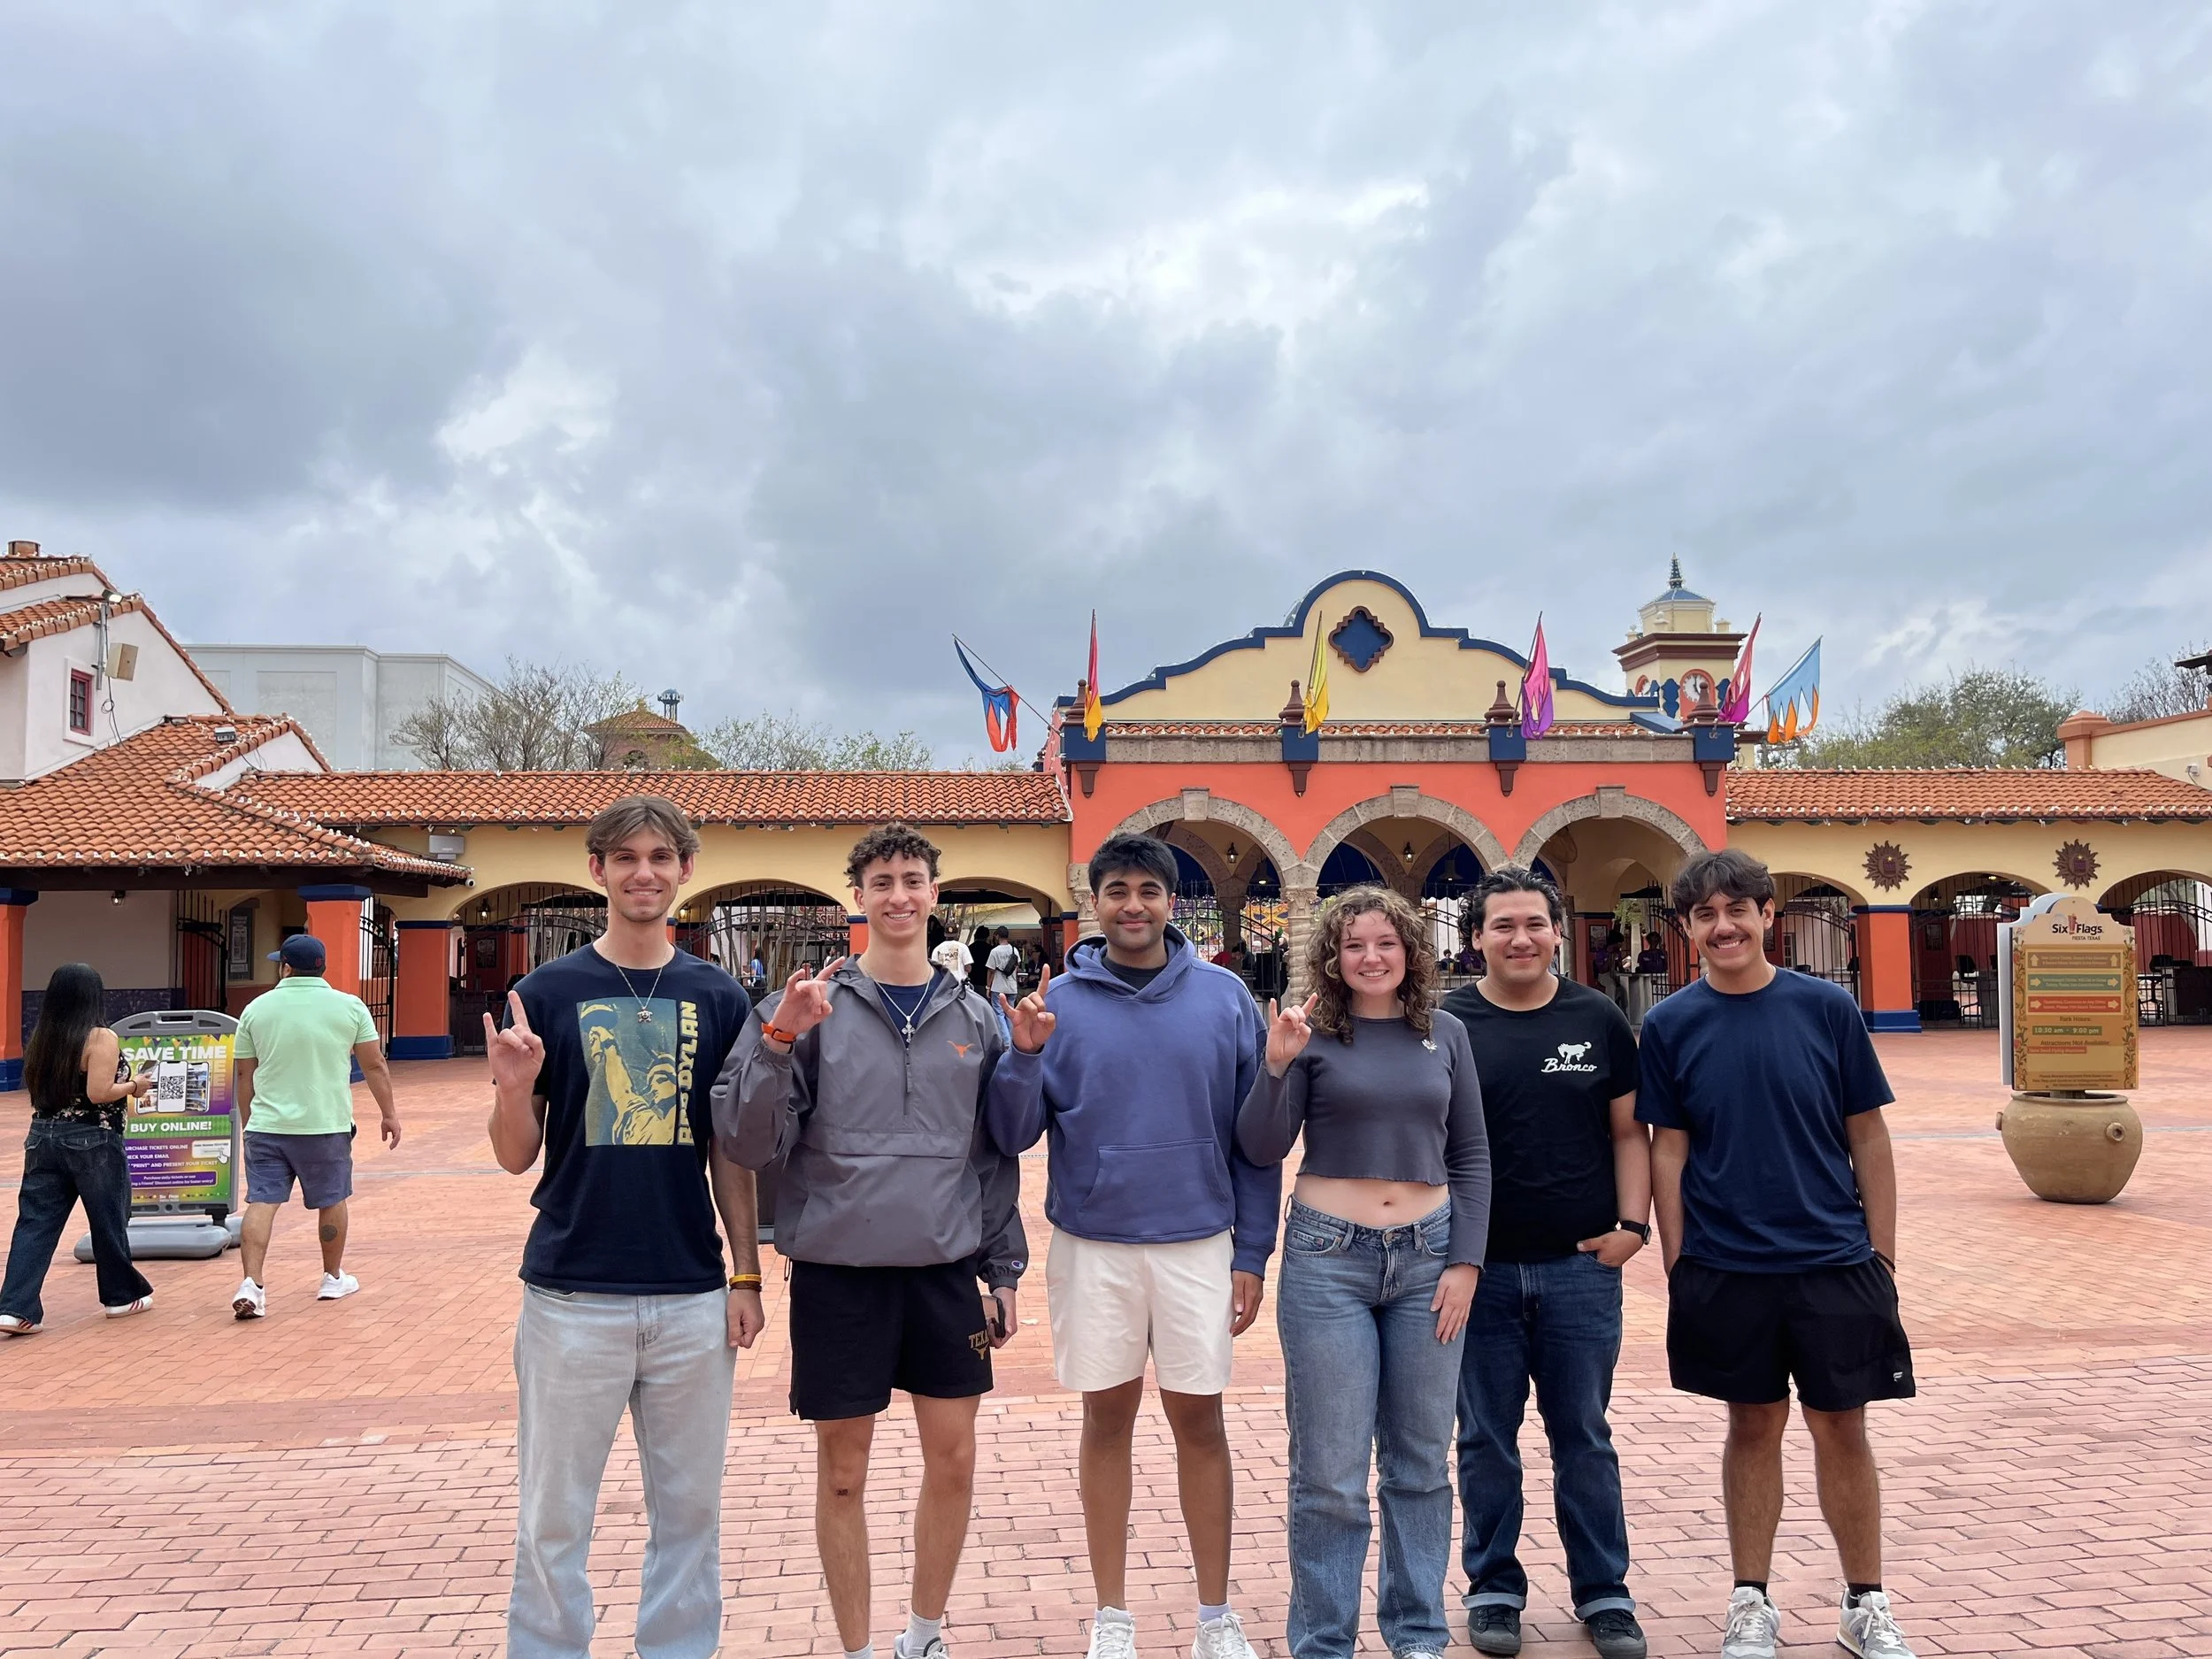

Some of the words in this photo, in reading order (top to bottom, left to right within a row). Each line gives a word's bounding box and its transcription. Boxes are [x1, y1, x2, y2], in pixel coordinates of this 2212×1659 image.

[2052, 924, 2068, 933] Six
[2076, 924, 2102, 935] Flags
[123, 1046, 174, 1061] SAVE
[179, 1045, 227, 1060] TIME
[677, 1001, 698, 1091] DYLAN
[1540, 1057, 1597, 1073] Bronco
[130, 1123, 157, 1133] BUY
[160, 1121, 212, 1132] ONLINE!
[968, 1329, 989, 1348] TEXA
